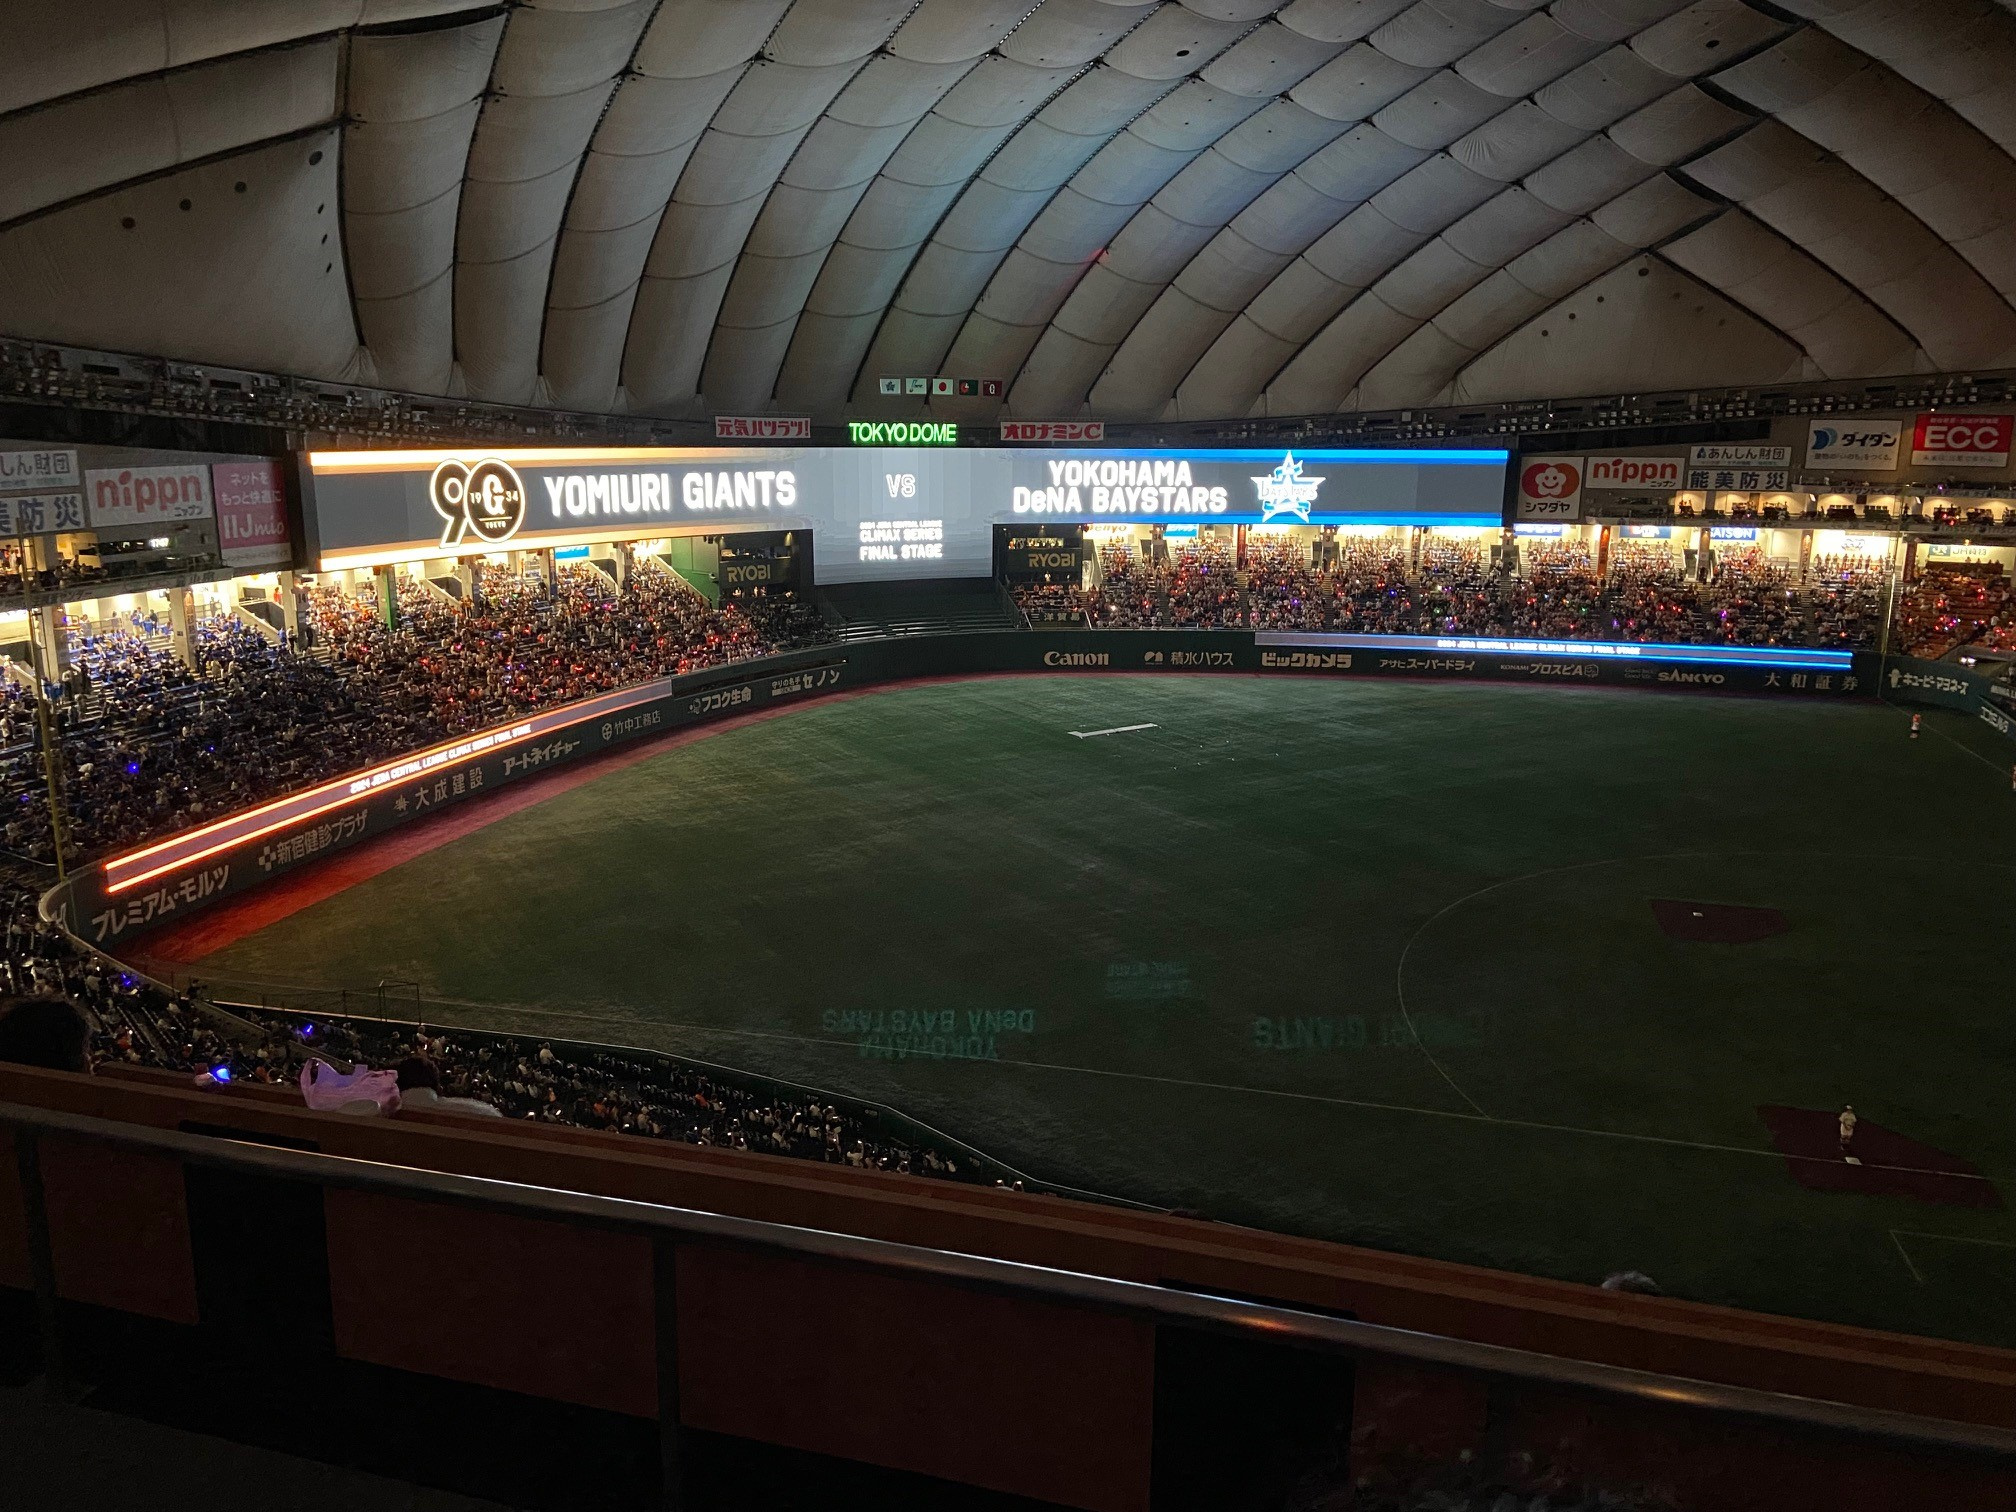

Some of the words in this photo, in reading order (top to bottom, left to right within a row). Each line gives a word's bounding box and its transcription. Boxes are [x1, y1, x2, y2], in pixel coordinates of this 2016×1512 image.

[849, 422, 907, 443] TOKYO
[909, 422, 957, 442] DOME
[1002, 421, 1101, 440] オロナミンC
[1841, 431, 1897, 447] ダイダン
[1924, 425, 2000, 450] ECC
[1708, 447, 1785, 460] あんしん財団
[1048, 459, 1193, 487] YOKOHAMA
[1592, 458, 1678, 484] nippn
[1690, 470, 1784, 490] 能美防災
[96, 469, 202, 513] nippn
[543, 473, 671, 518] YOMIURI
[682, 470, 796, 511] GIANTS
[885, 473, 916, 498] VS
[1649, 480, 1676, 488] ニップン
[1013, 486, 1083, 513] DeNA
[1091, 485, 1228, 513] BAYSTARS
[1525, 500, 1571, 513] シマダヤ
[174, 505, 204, 518] ニップン
[860, 528, 901, 543] CLIMAX
[903, 527, 943, 541] SERIES
[860, 544, 898, 561] FINAL
[901, 543, 943, 559] STAGE
[1028, 553, 1076, 568] RYOBI
[726, 564, 771, 583] RYOBI
[1043, 651, 1110, 666] Canon
[1170, 651, 1235, 666] 積水ハウス
[1261, 652, 1352, 668] ビックカメラ
[803, 669, 840, 689] セノン
[1500, 663, 1529, 672] KONAMI
[1529, 662, 1583, 676] プロスピA
[1765, 672, 1858, 691] 大和証券
[702, 687, 752, 712] フコク生命
[614, 710, 661, 735] 竹中工務店
[503, 740, 581, 776] アートネイチャー
[415, 766, 483, 810] 大成建設
[276, 809, 368, 865] 新宿健診プラザ
[92, 864, 230, 943] プレミアム・モルツ
